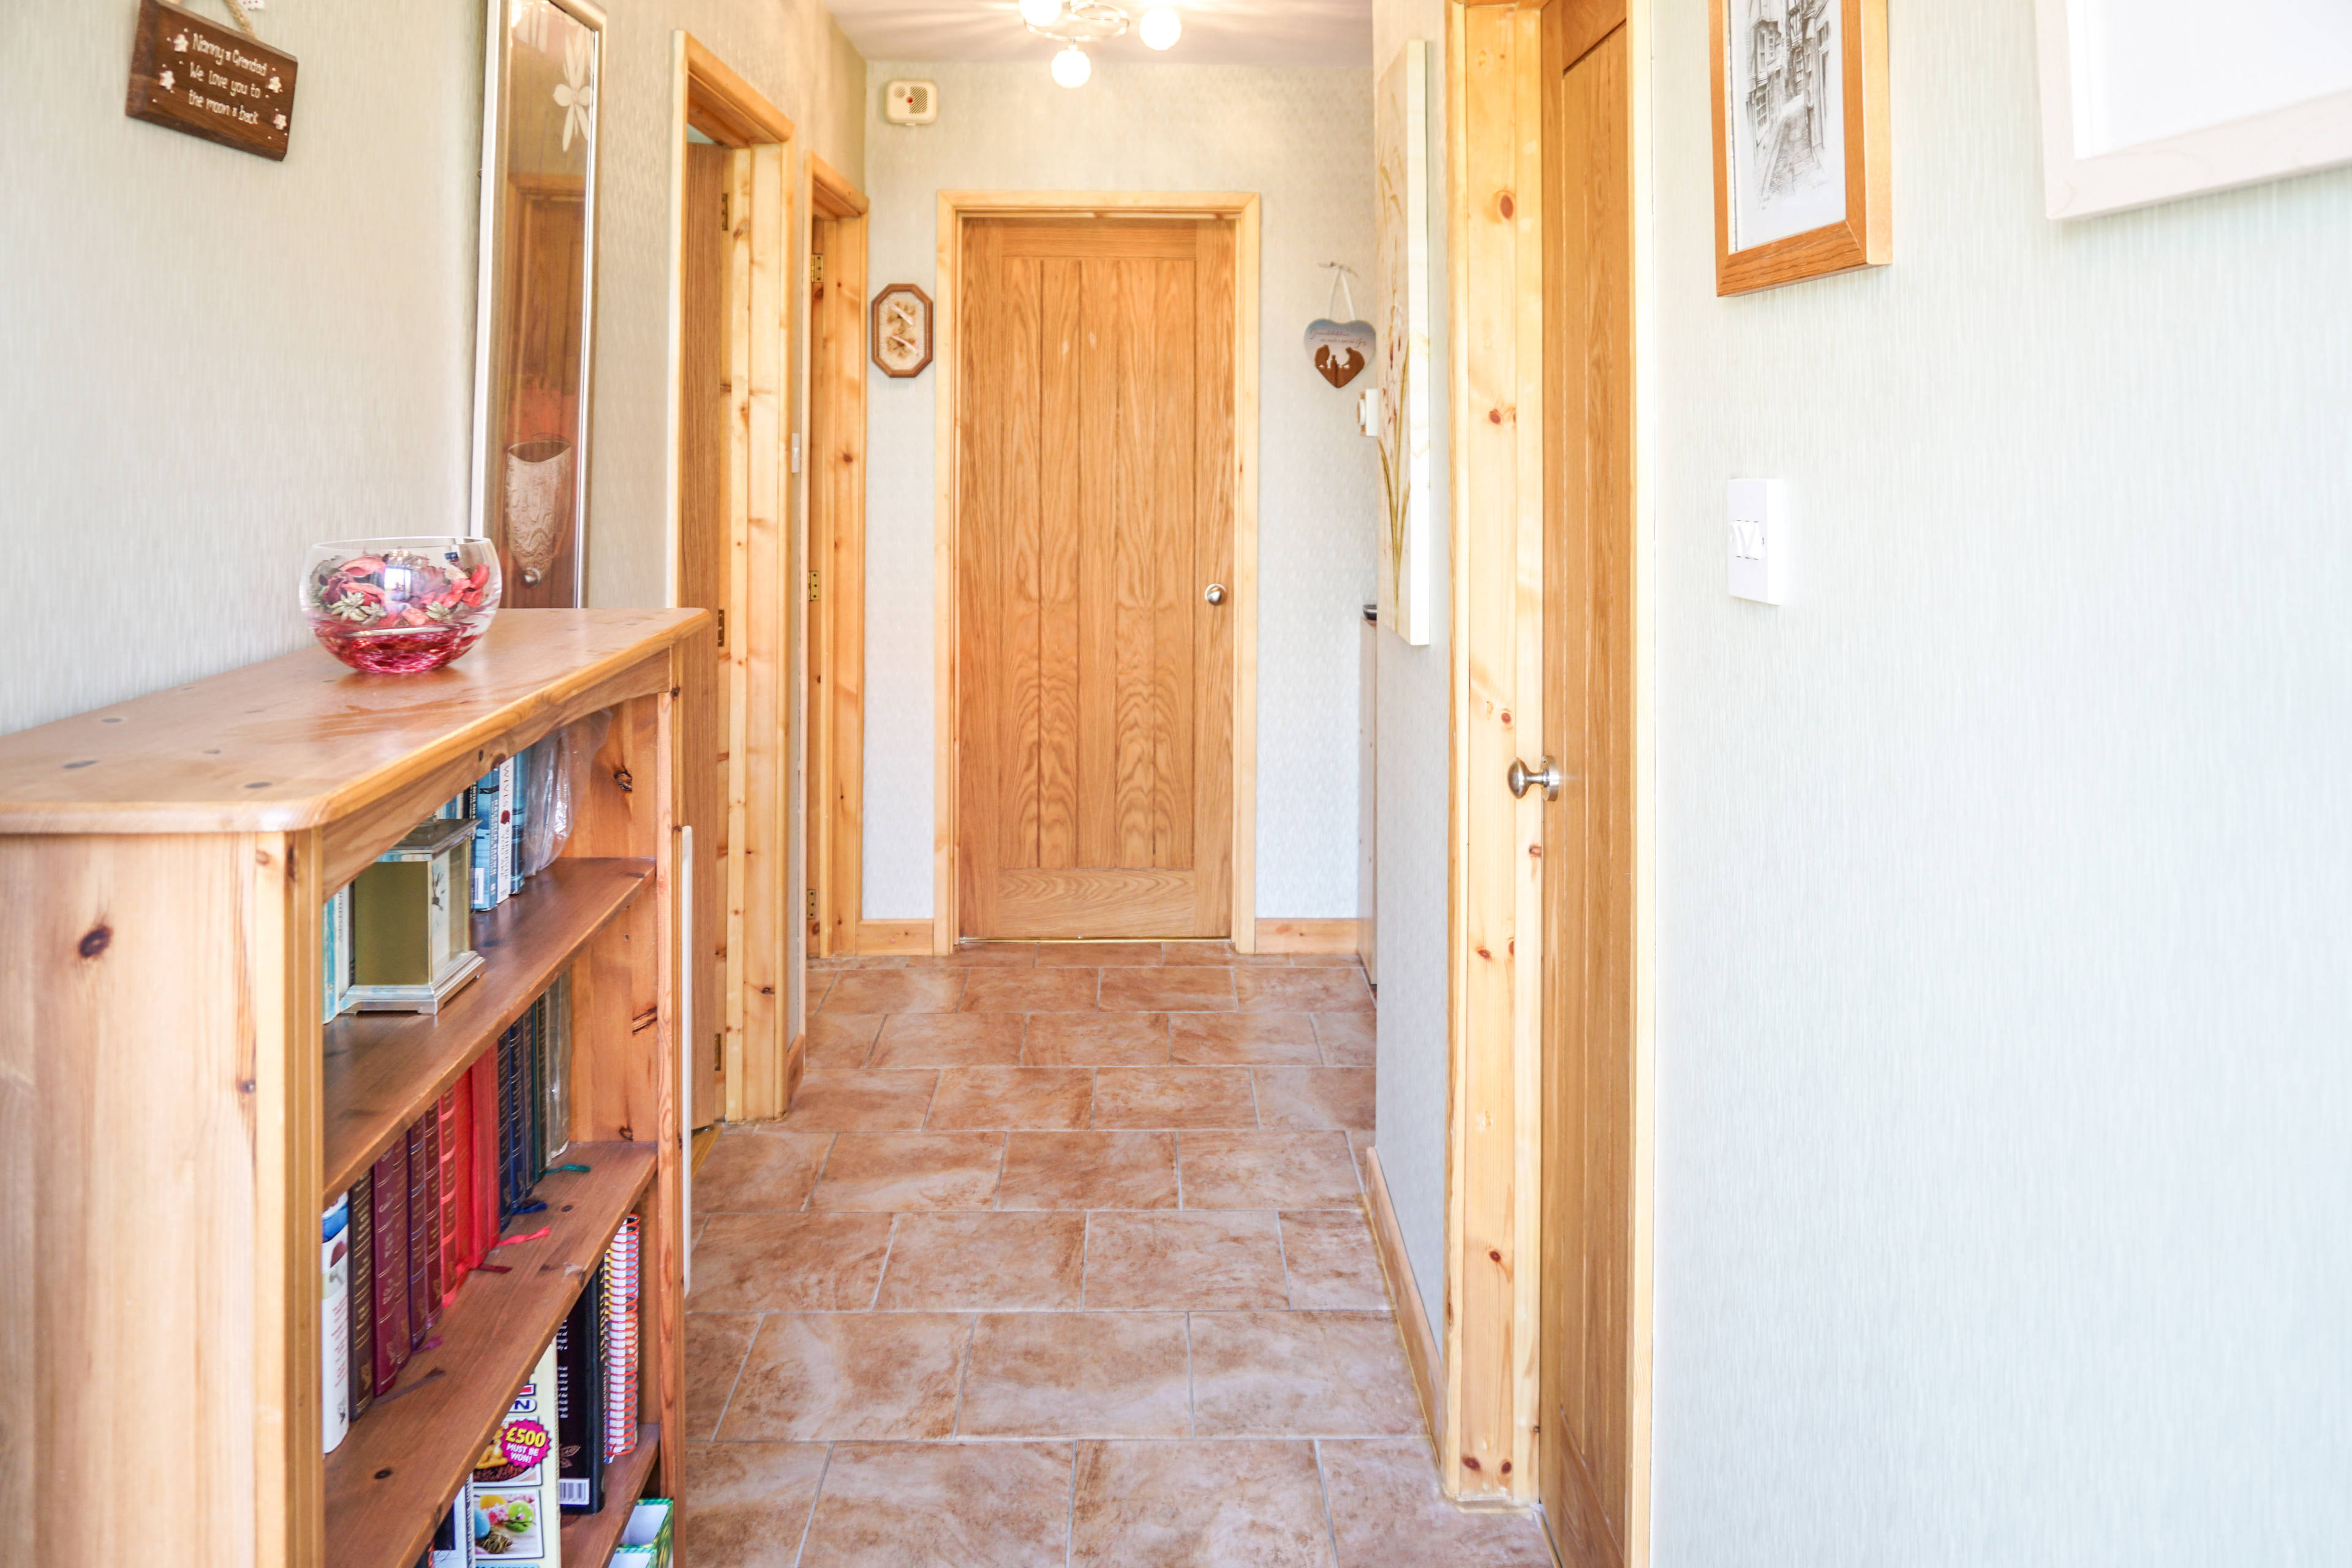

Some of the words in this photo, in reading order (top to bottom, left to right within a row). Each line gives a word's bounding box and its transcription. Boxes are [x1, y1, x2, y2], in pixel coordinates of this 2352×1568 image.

[233, 49, 268, 77] Grandad
[189, 61, 205, 81] We
[208, 70, 228, 89] love
[230, 80, 248, 97] you
[251, 83, 261, 98] to
[188, 89, 203, 107] the
[206, 98, 230, 116] moon
[238, 105, 258, 124] back
[505, 1427, 546, 1447] £500
[506, 1442, 527, 1453] MUST
[528, 1447, 539, 1457] BE
[510, 1452, 532, 1463] WON!
